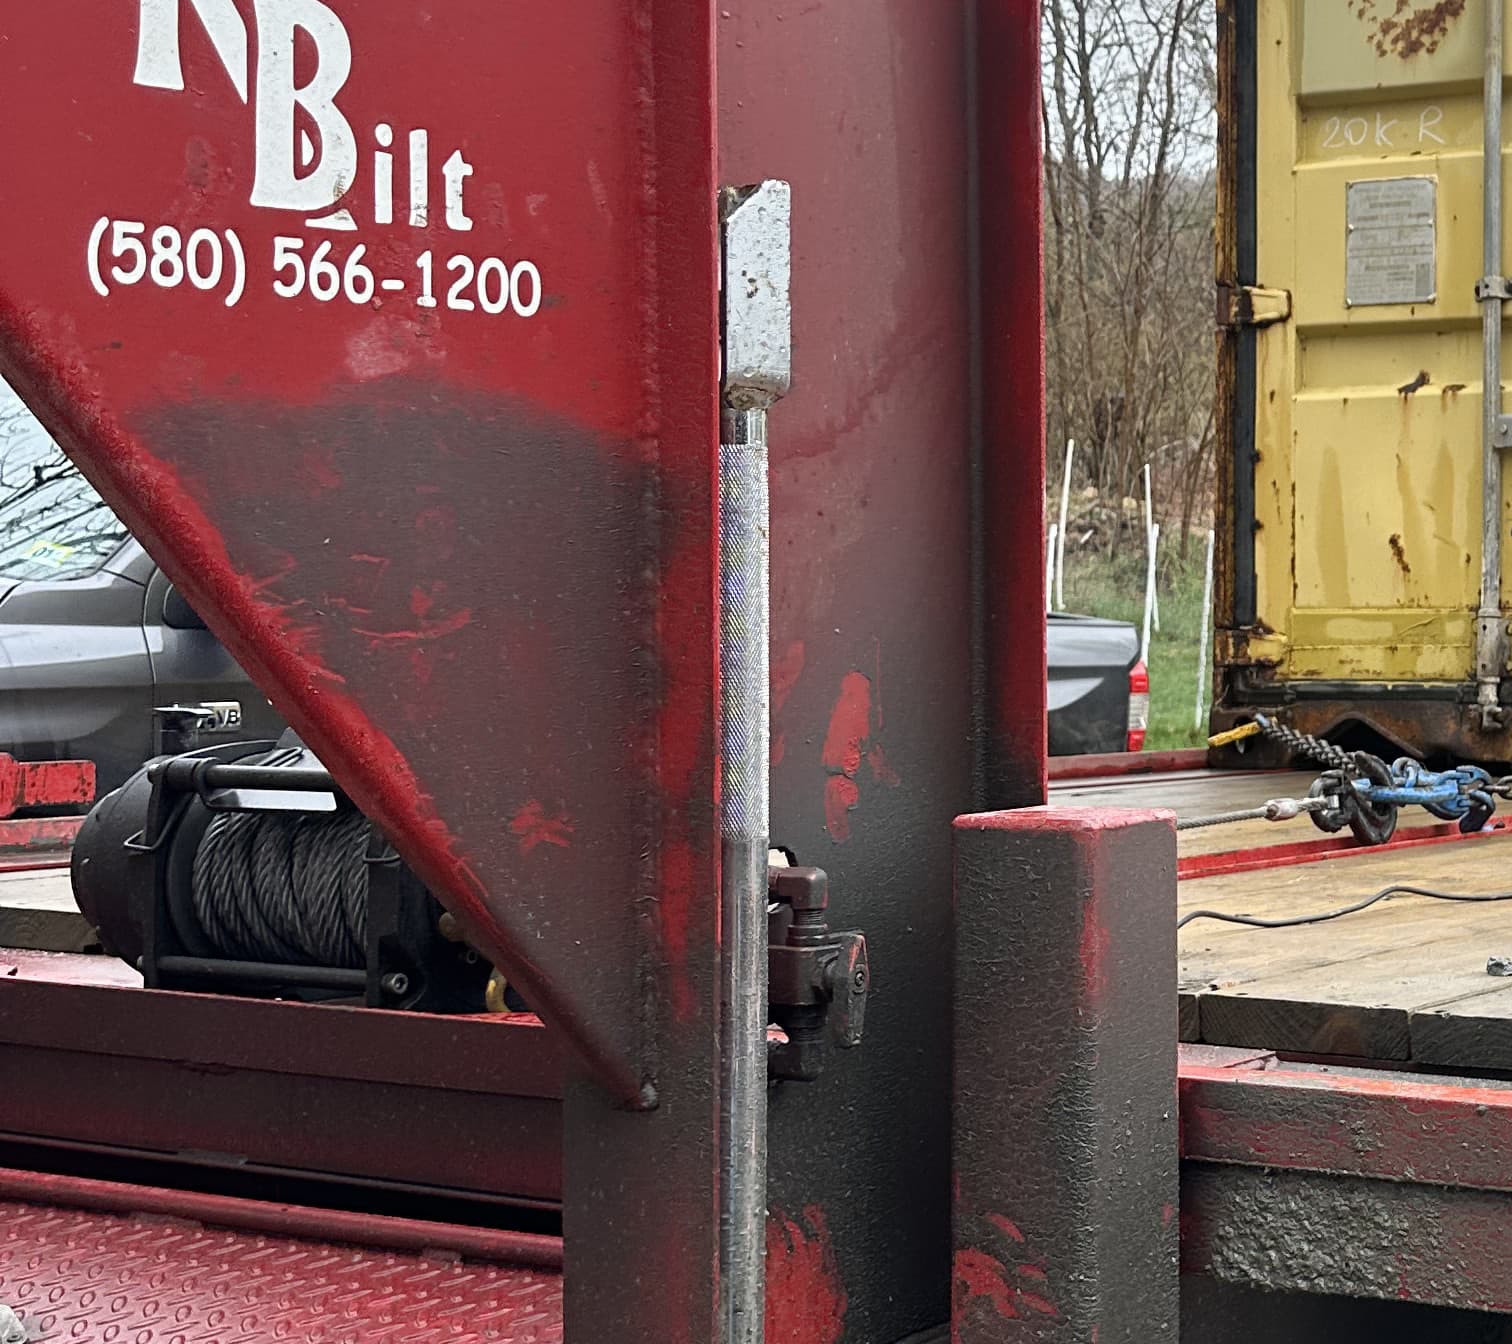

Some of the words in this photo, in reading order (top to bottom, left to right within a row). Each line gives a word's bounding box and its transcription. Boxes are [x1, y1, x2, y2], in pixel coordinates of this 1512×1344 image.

[1418, 106, 1446, 145] R
[87, 216, 247, 307] (580)
[273, 237, 542, 317] 566-1200
